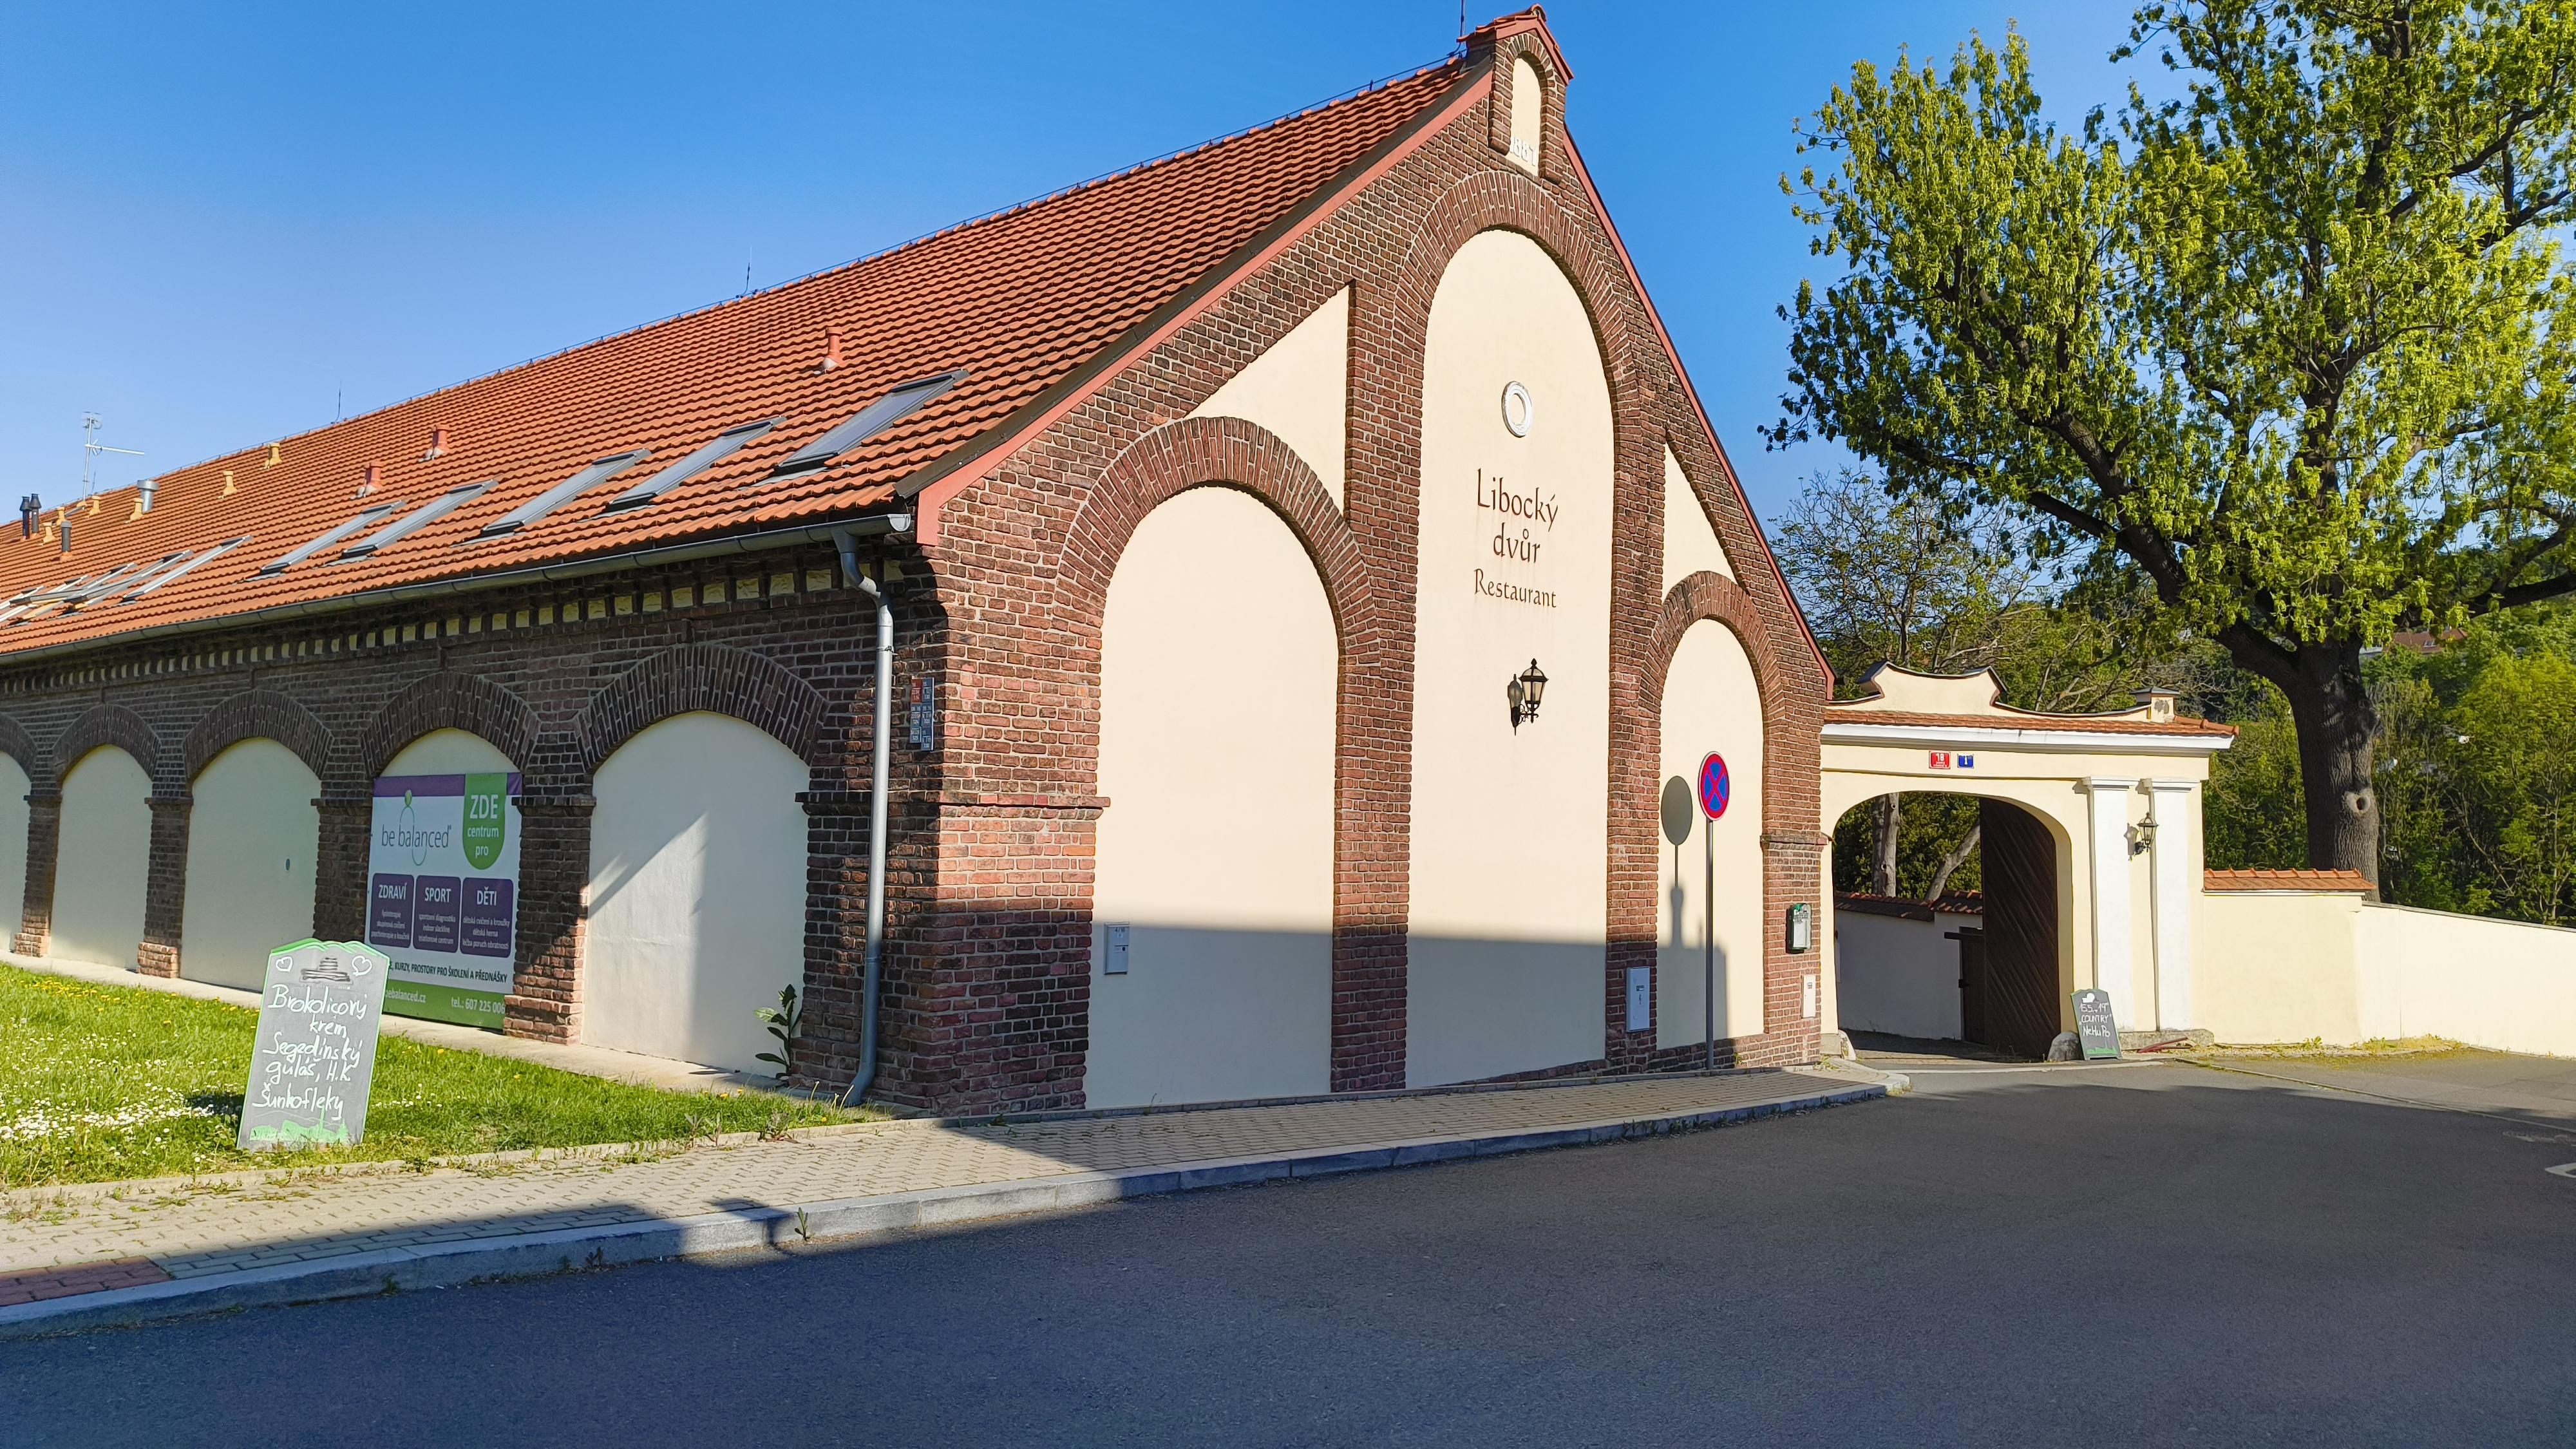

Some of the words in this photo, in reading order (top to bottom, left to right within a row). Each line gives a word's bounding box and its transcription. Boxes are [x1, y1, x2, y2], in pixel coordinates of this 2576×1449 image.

[1477, 468, 1558, 532] Libocký
[1493, 522, 1540, 564] dvůr
[1473, 568, 1557, 608] Restaurant
[1936, 753, 1945, 762] 18
[469, 794, 499, 819] ZDE
[382, 824, 395, 847] be
[398, 824, 450, 848] balanced
[468, 826, 499, 837] centrum
[475, 846, 489, 858] pro
[379, 882, 407, 900] ZDRAVÍ
[424, 887, 451, 903] SPORT
[477, 886, 497, 906] DĚTI
[395, 961, 410, 973] KURZY,
[412, 963, 437, 974] PROSTORY
[437, 967, 448, 976] PRO
[448, 967, 470, 979] ŠKOLENÍ
[470, 971, 474, 980] A
[475, 969, 507, 983] PŘEDNÁŠKY
[268, 984, 368, 1020] Brokolicový
[465, 998, 477, 1010] 607
[479, 1001, 491, 1012] 225
[493, 1001, 506, 1014] 006
[262, 1031, 363, 1068] Segedínský
[265, 1054, 321, 1084] guláš,
[252, 1082, 344, 1121] Šunkofleky
